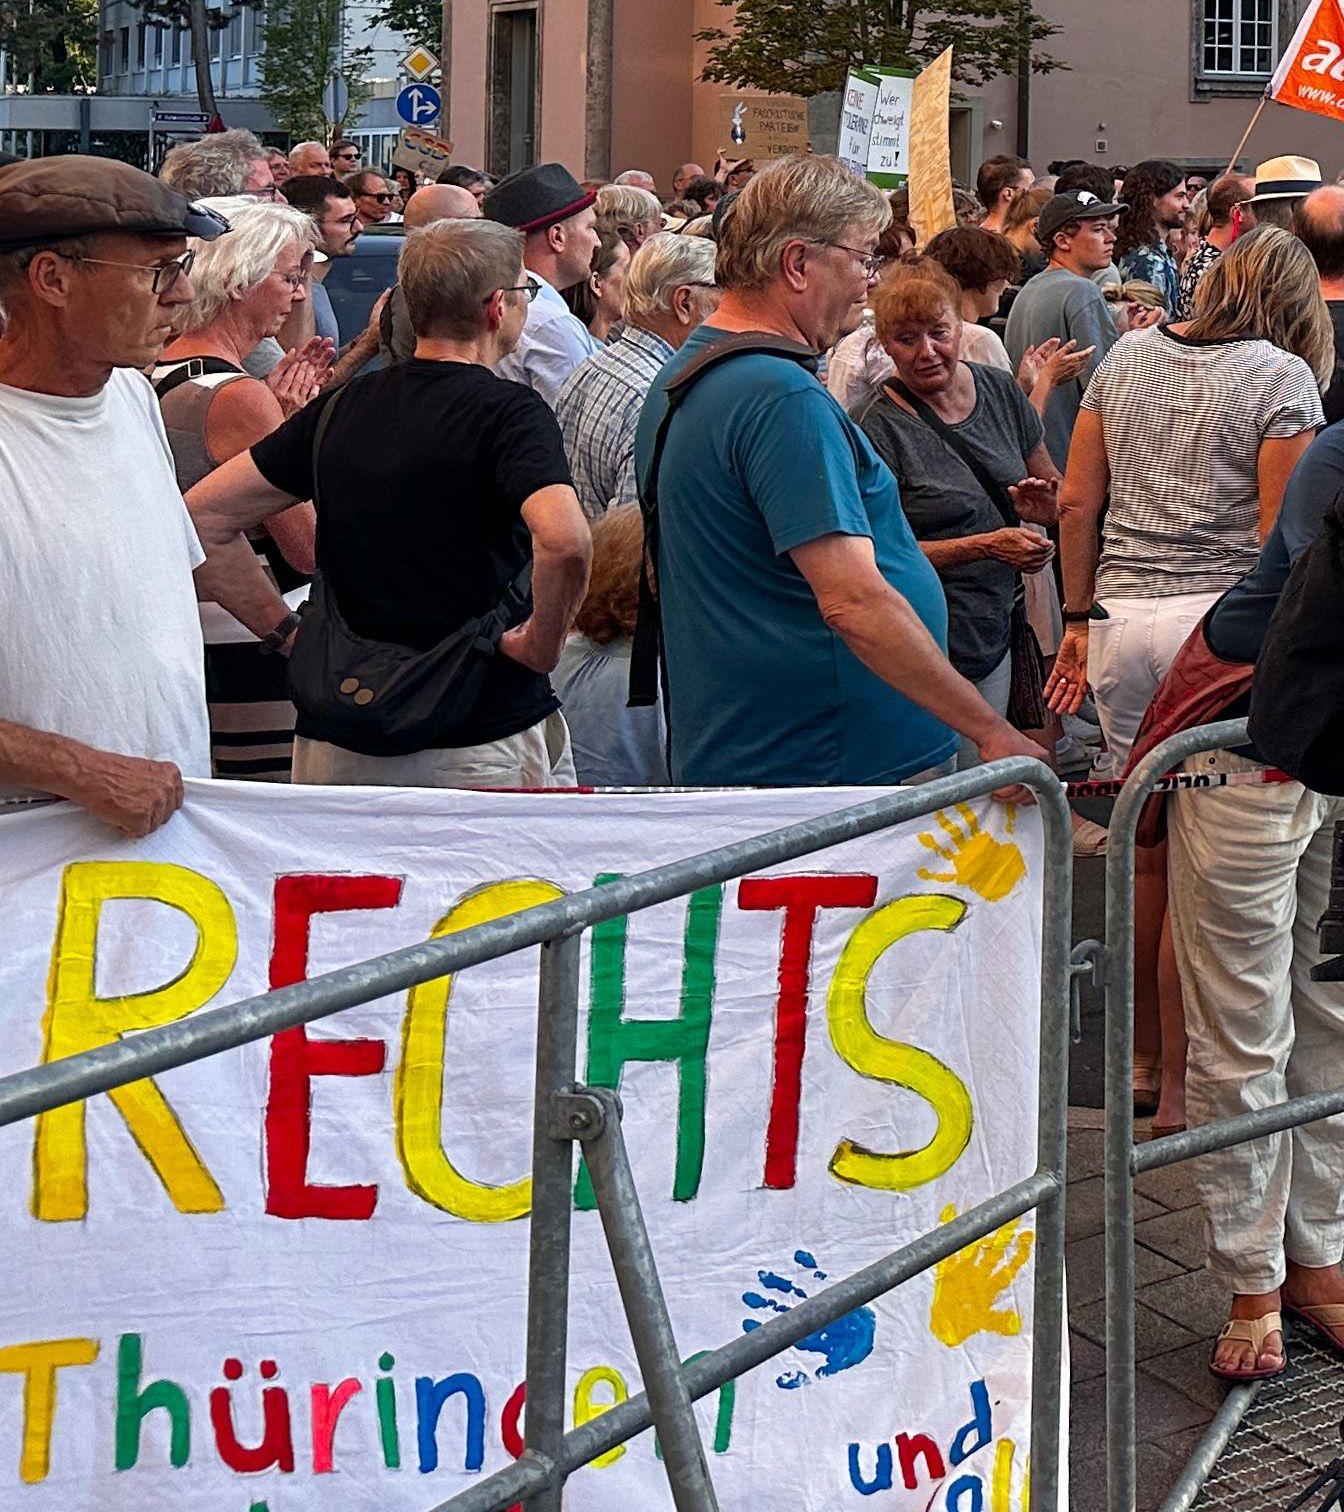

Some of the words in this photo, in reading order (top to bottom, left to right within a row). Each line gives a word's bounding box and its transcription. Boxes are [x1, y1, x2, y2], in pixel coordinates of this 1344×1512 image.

[880, 89, 900, 106] Wer
[30, 859, 975, 1223] RECHTS
[848, 1377, 993, 1496] und
